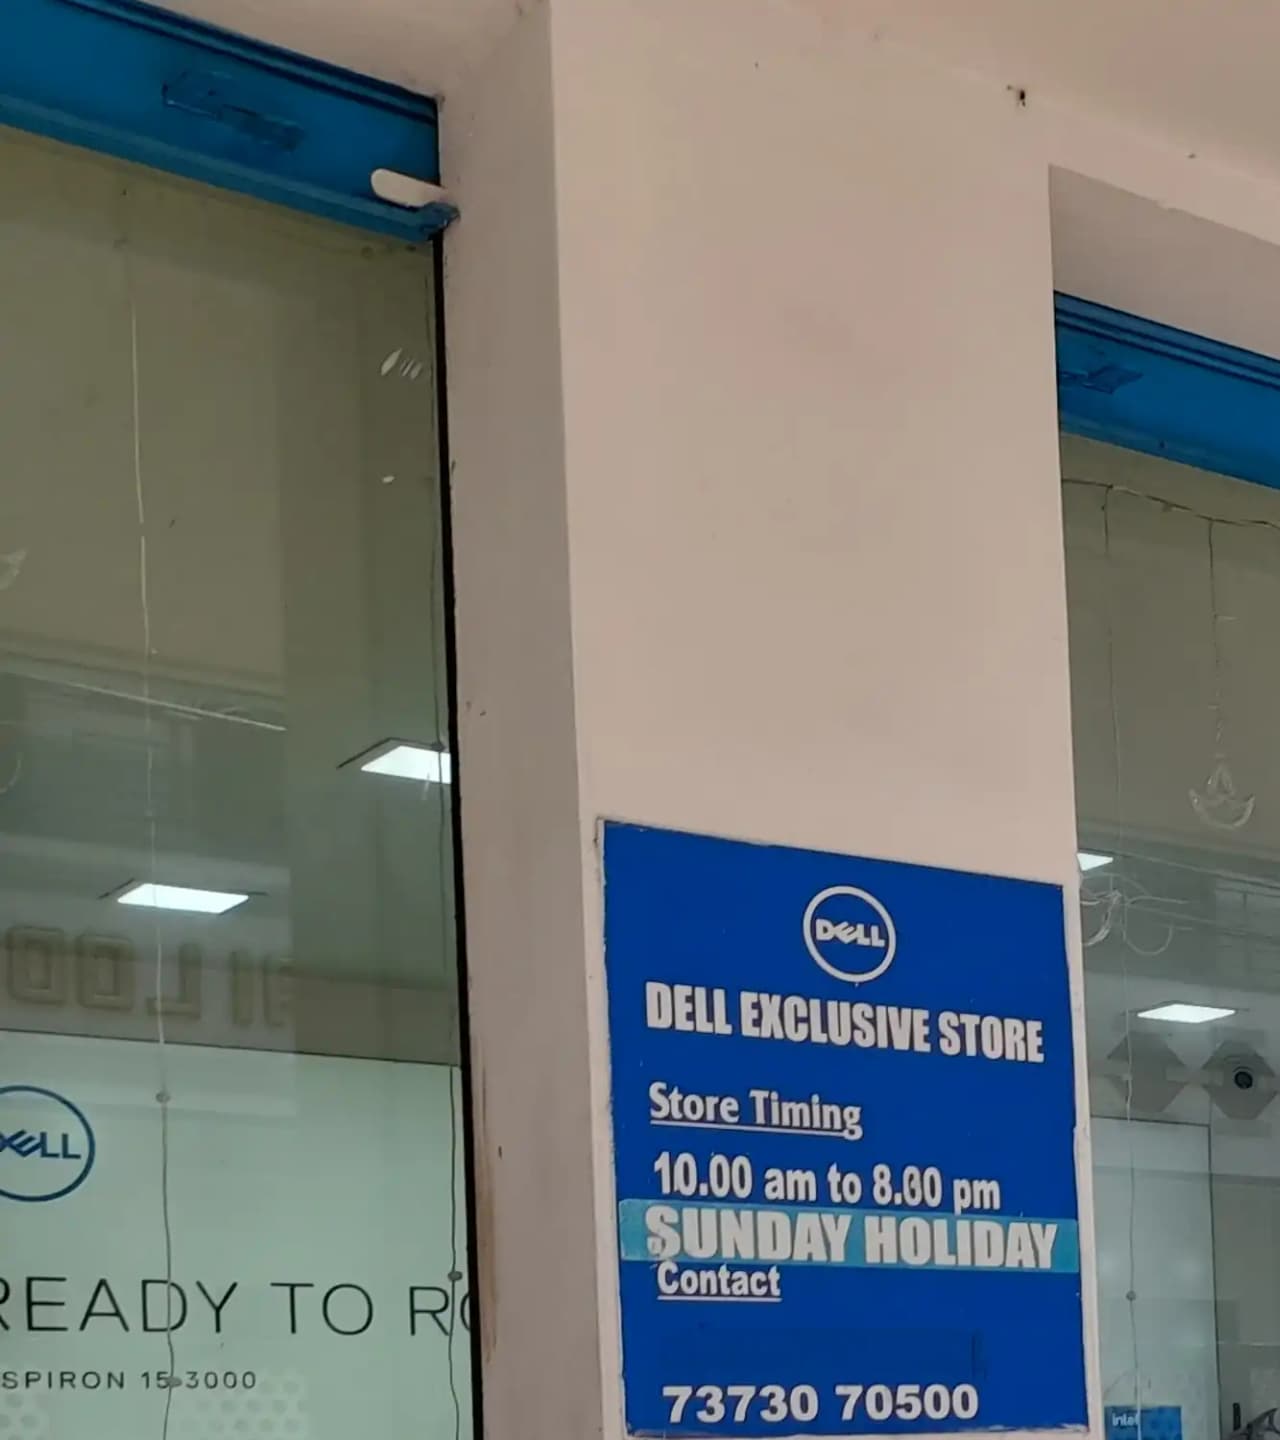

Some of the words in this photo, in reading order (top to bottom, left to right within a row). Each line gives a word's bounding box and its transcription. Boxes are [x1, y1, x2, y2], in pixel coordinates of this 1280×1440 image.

[815, 918, 885, 948] DELL
[645, 981, 732, 1036] DELL
[740, 990, 931, 1053] EXCLUSIVE
[938, 1011, 1045, 1063] STORE
[648, 1081, 740, 1126] Store
[749, 1089, 864, 1140] Timing
[653, 1151, 753, 1198] 10.00
[764, 1166, 817, 1202] am
[827, 1162, 863, 1204] to
[952, 1176, 1002, 1216] pm
[645, 1205, 854, 1262] SUNDAY
[864, 1215, 1058, 1269] HOLIDAY
[657, 1261, 781, 1300] Contact
[271, 1282, 374, 1336] TO
[186, 1371, 257, 1390] 3000
[663, 1386, 819, 1424] 73730
[835, 1384, 979, 1421] 70500
